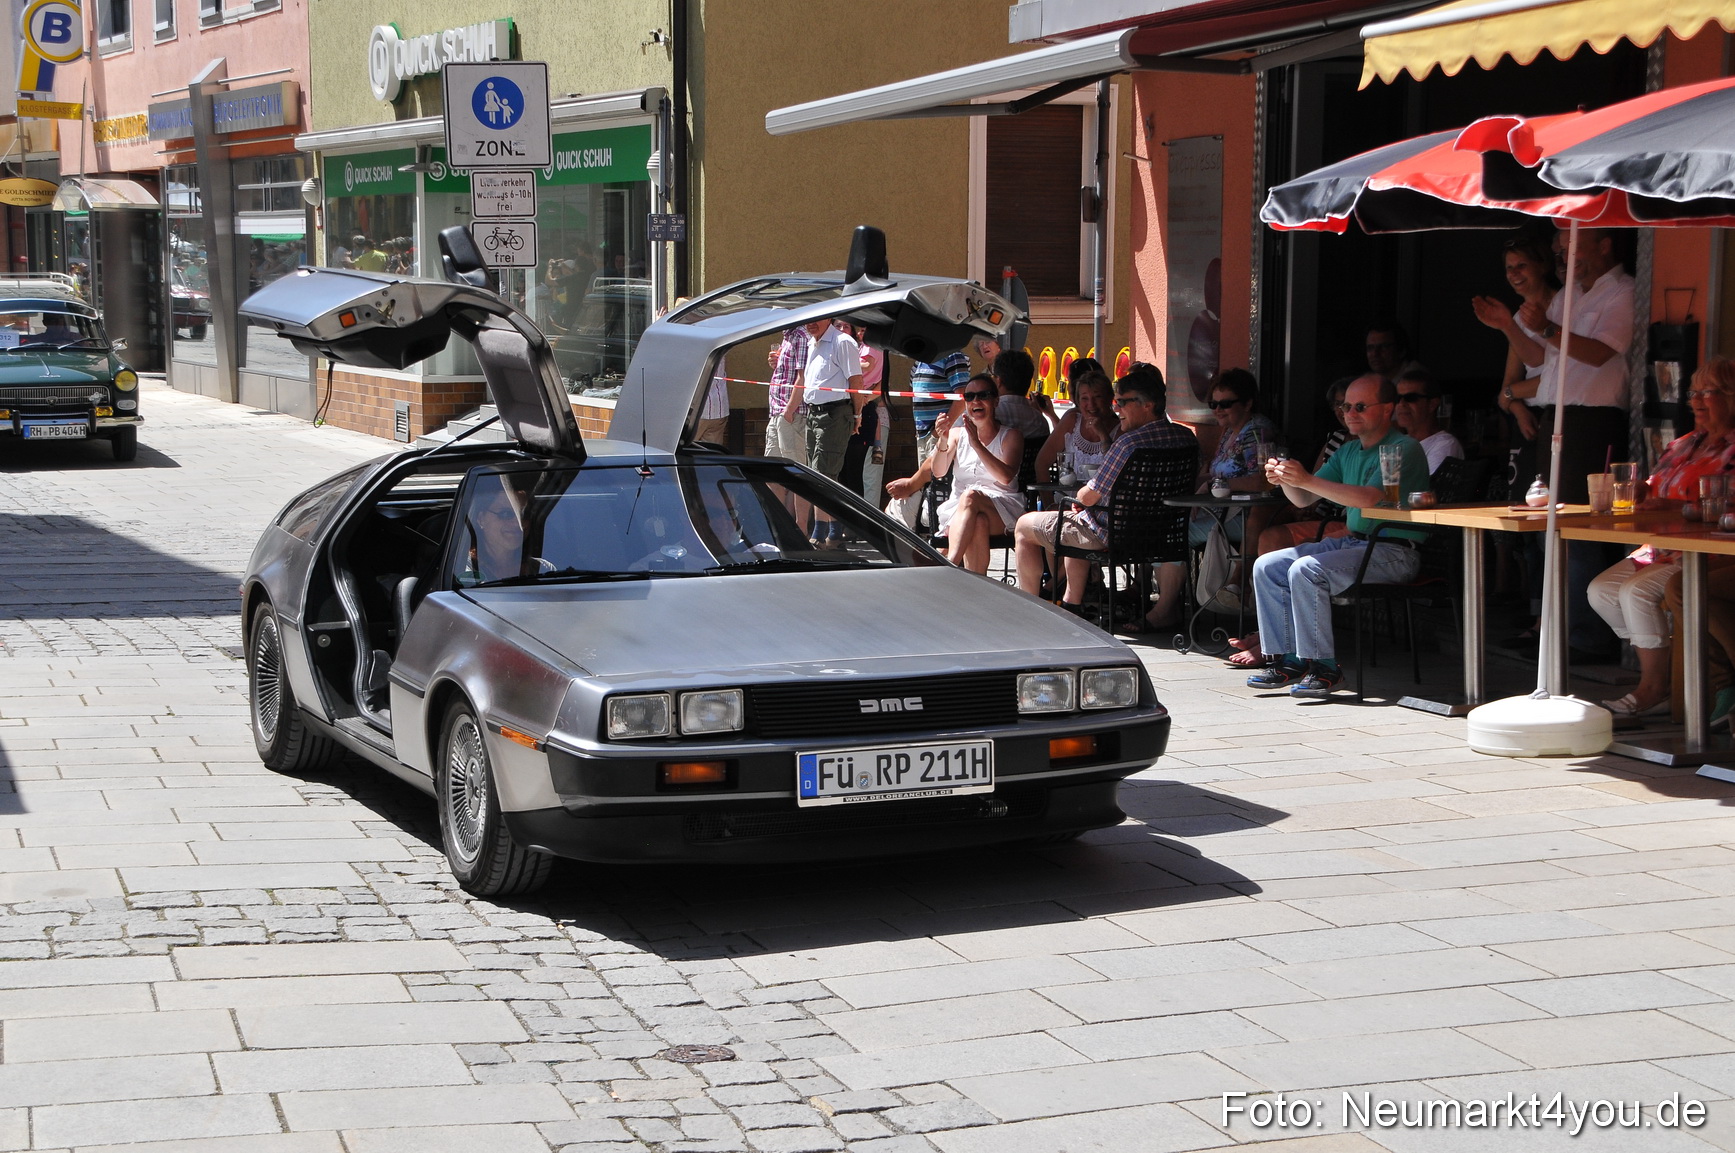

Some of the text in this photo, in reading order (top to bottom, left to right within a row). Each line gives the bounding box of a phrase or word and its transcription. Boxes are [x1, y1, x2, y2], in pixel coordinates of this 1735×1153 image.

[41, 11, 72, 44] B
[394, 33, 440, 80] QUICK
[442, 20, 497, 63] SCHUH
[20, 104, 76, 115] KLOSTERGASSE
[556, 147, 612, 172] QUICK SCHUH
[355, 167, 372, 184] QUICK
[373, 165, 393, 182] SCHUH
[497, 202, 513, 211] frei
[495, 252, 515, 263] frei
[30, 427, 42, 437] RH
[49, 427, 61, 437] PB
[804, 747, 988, 790] D FÜ RP 211H
[845, 789, 951, 802] WWW.DELOREANCLUB.DE
